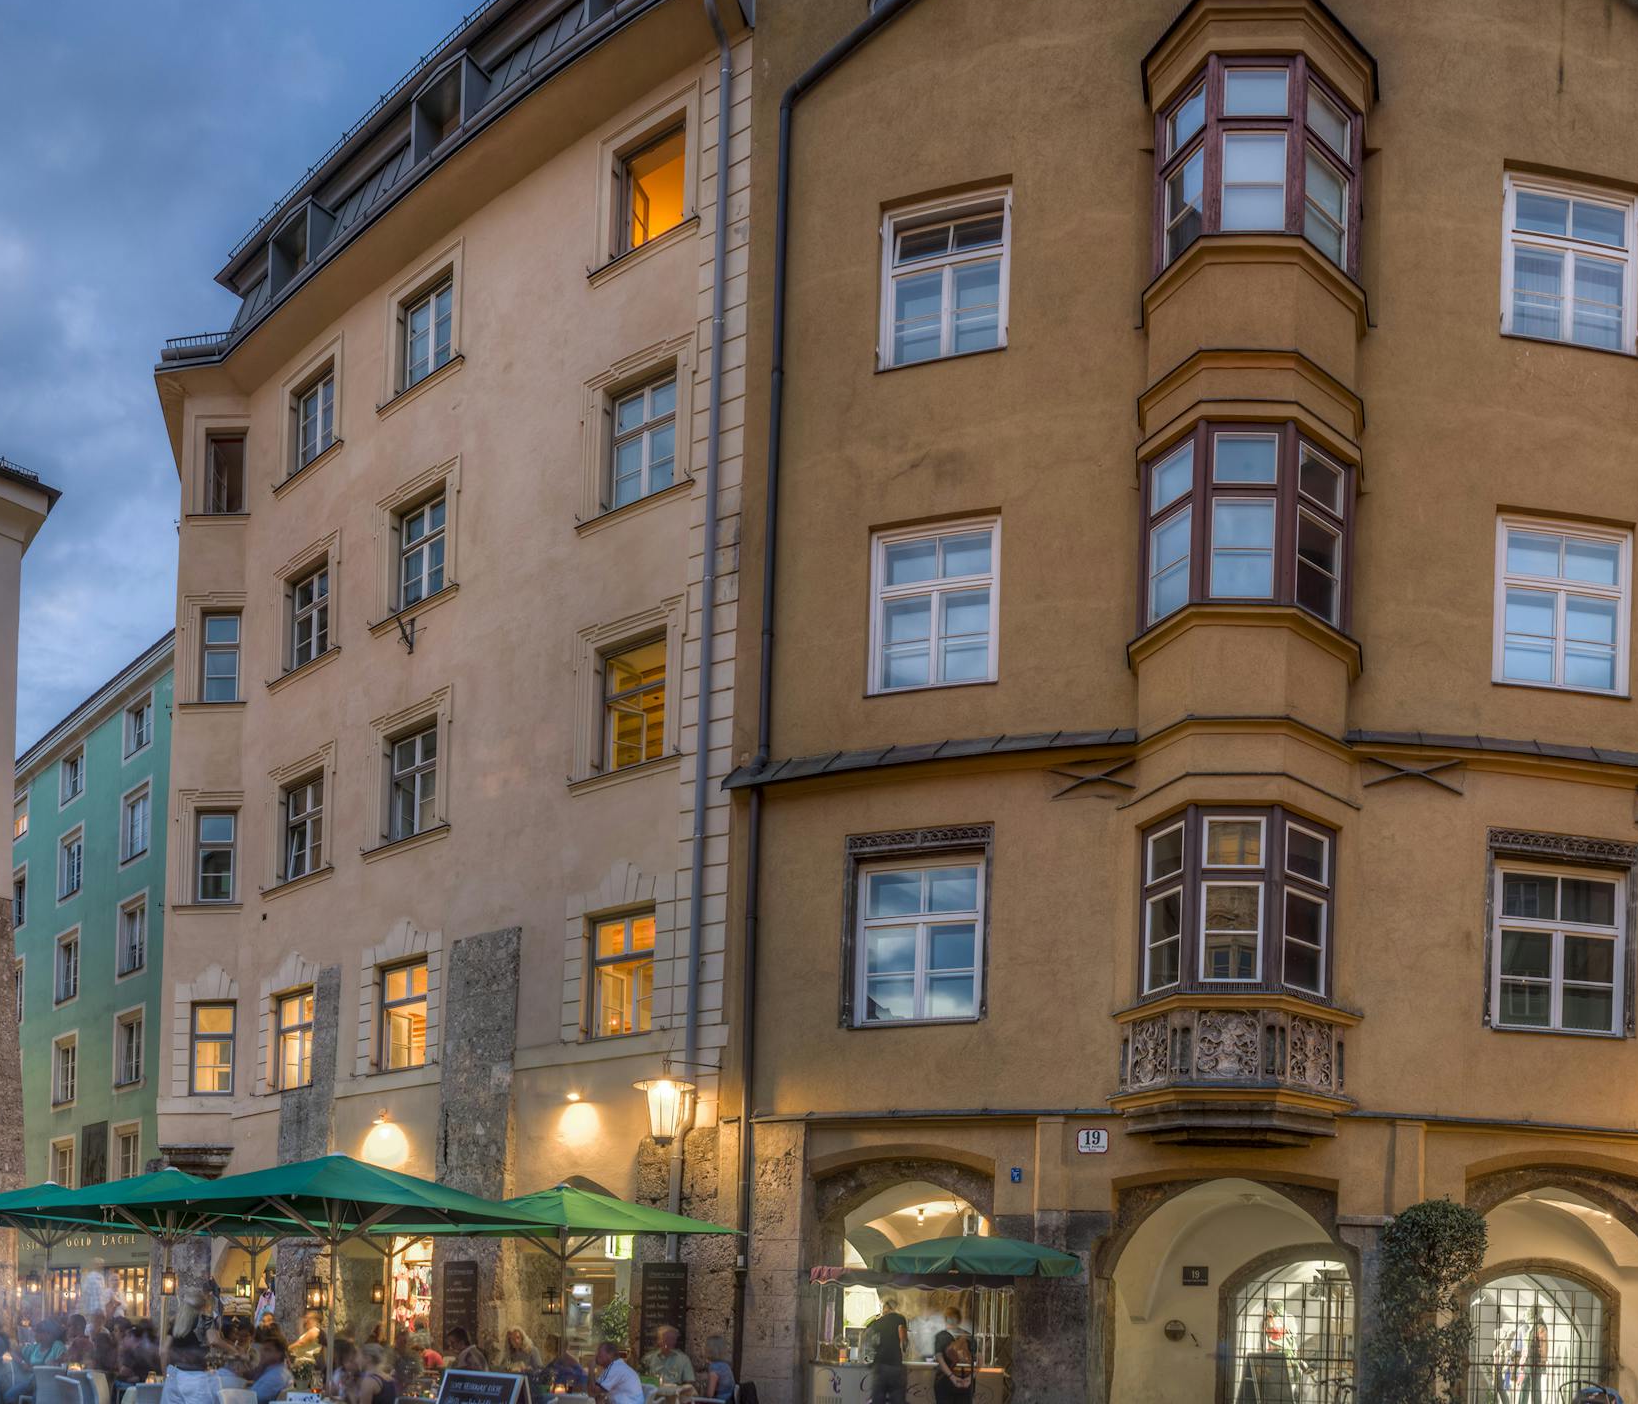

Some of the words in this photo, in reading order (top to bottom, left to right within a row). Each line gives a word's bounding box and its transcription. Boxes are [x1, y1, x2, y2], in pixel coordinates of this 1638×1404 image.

[1084, 1130, 1101, 1146] 19
[65, 1237, 93, 1248] GOLD
[1191, 1269, 1200, 1279] 19
